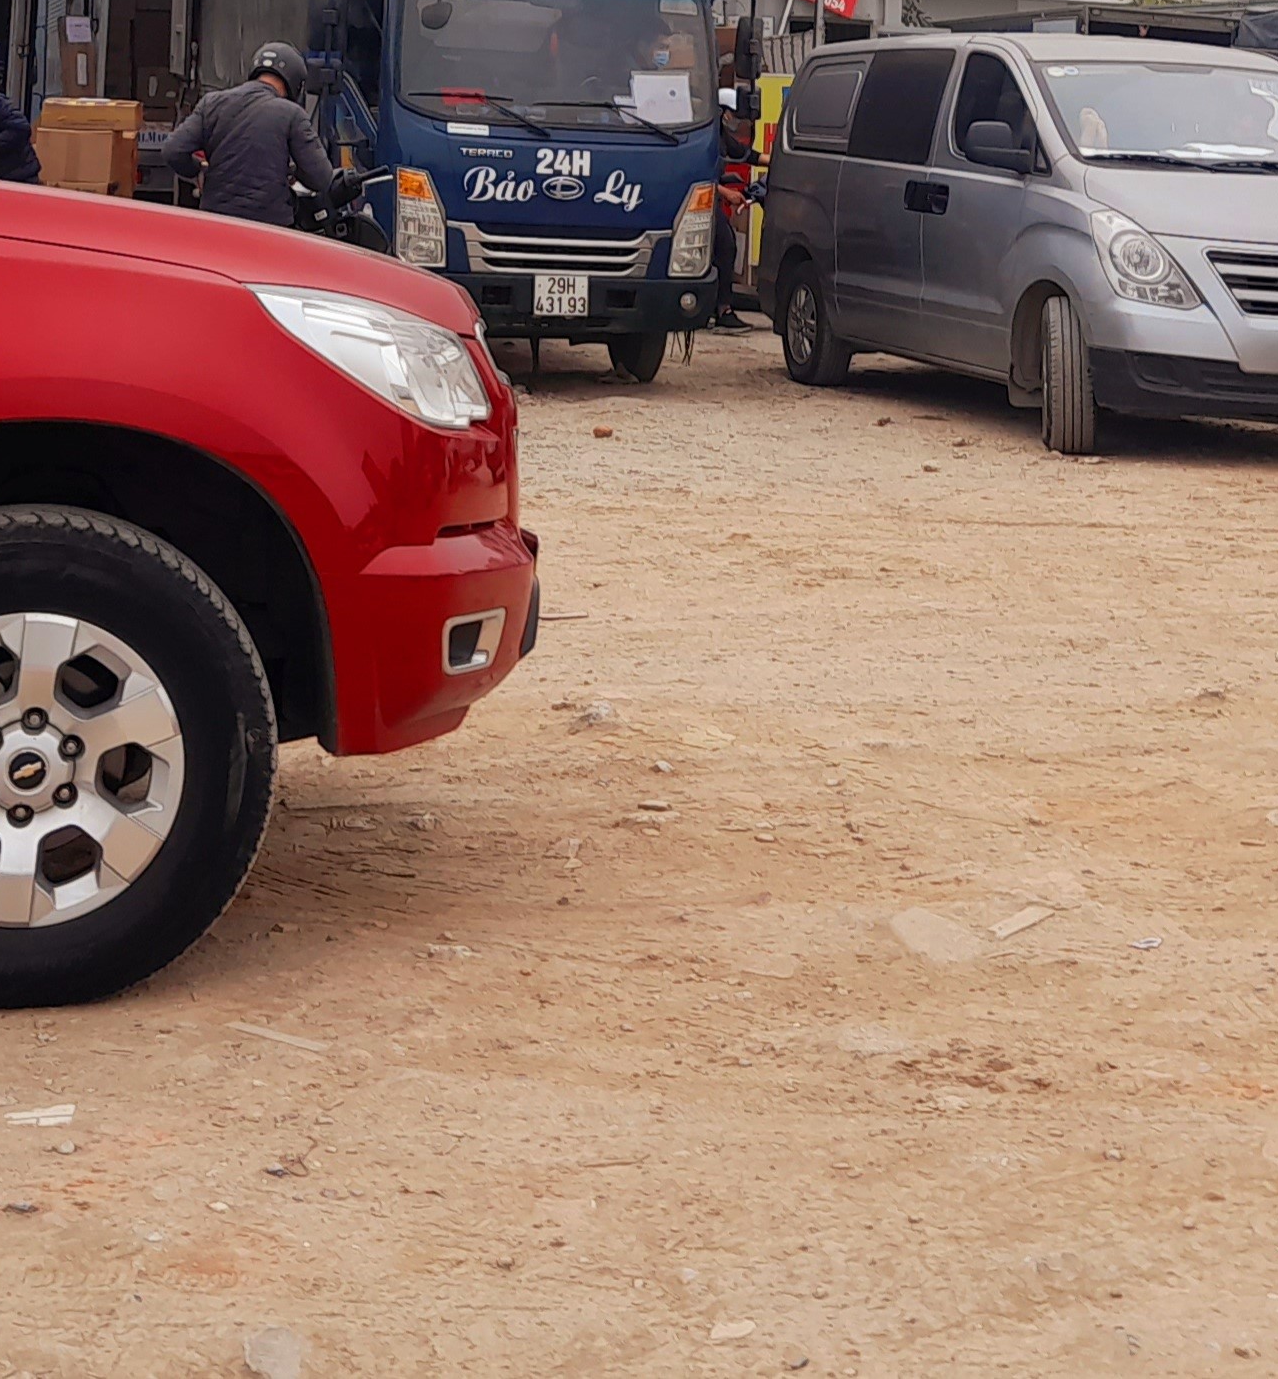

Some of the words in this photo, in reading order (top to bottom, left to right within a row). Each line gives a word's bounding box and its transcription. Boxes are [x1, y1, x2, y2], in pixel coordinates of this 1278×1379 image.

[460, 147, 513, 159] TERACO
[536, 148, 591, 177] 24H
[464, 166, 537, 201] Bảo
[593, 170, 643, 212] Ly
[547, 277, 576, 295] 29H
[535, 296, 587, 314] 431.93
